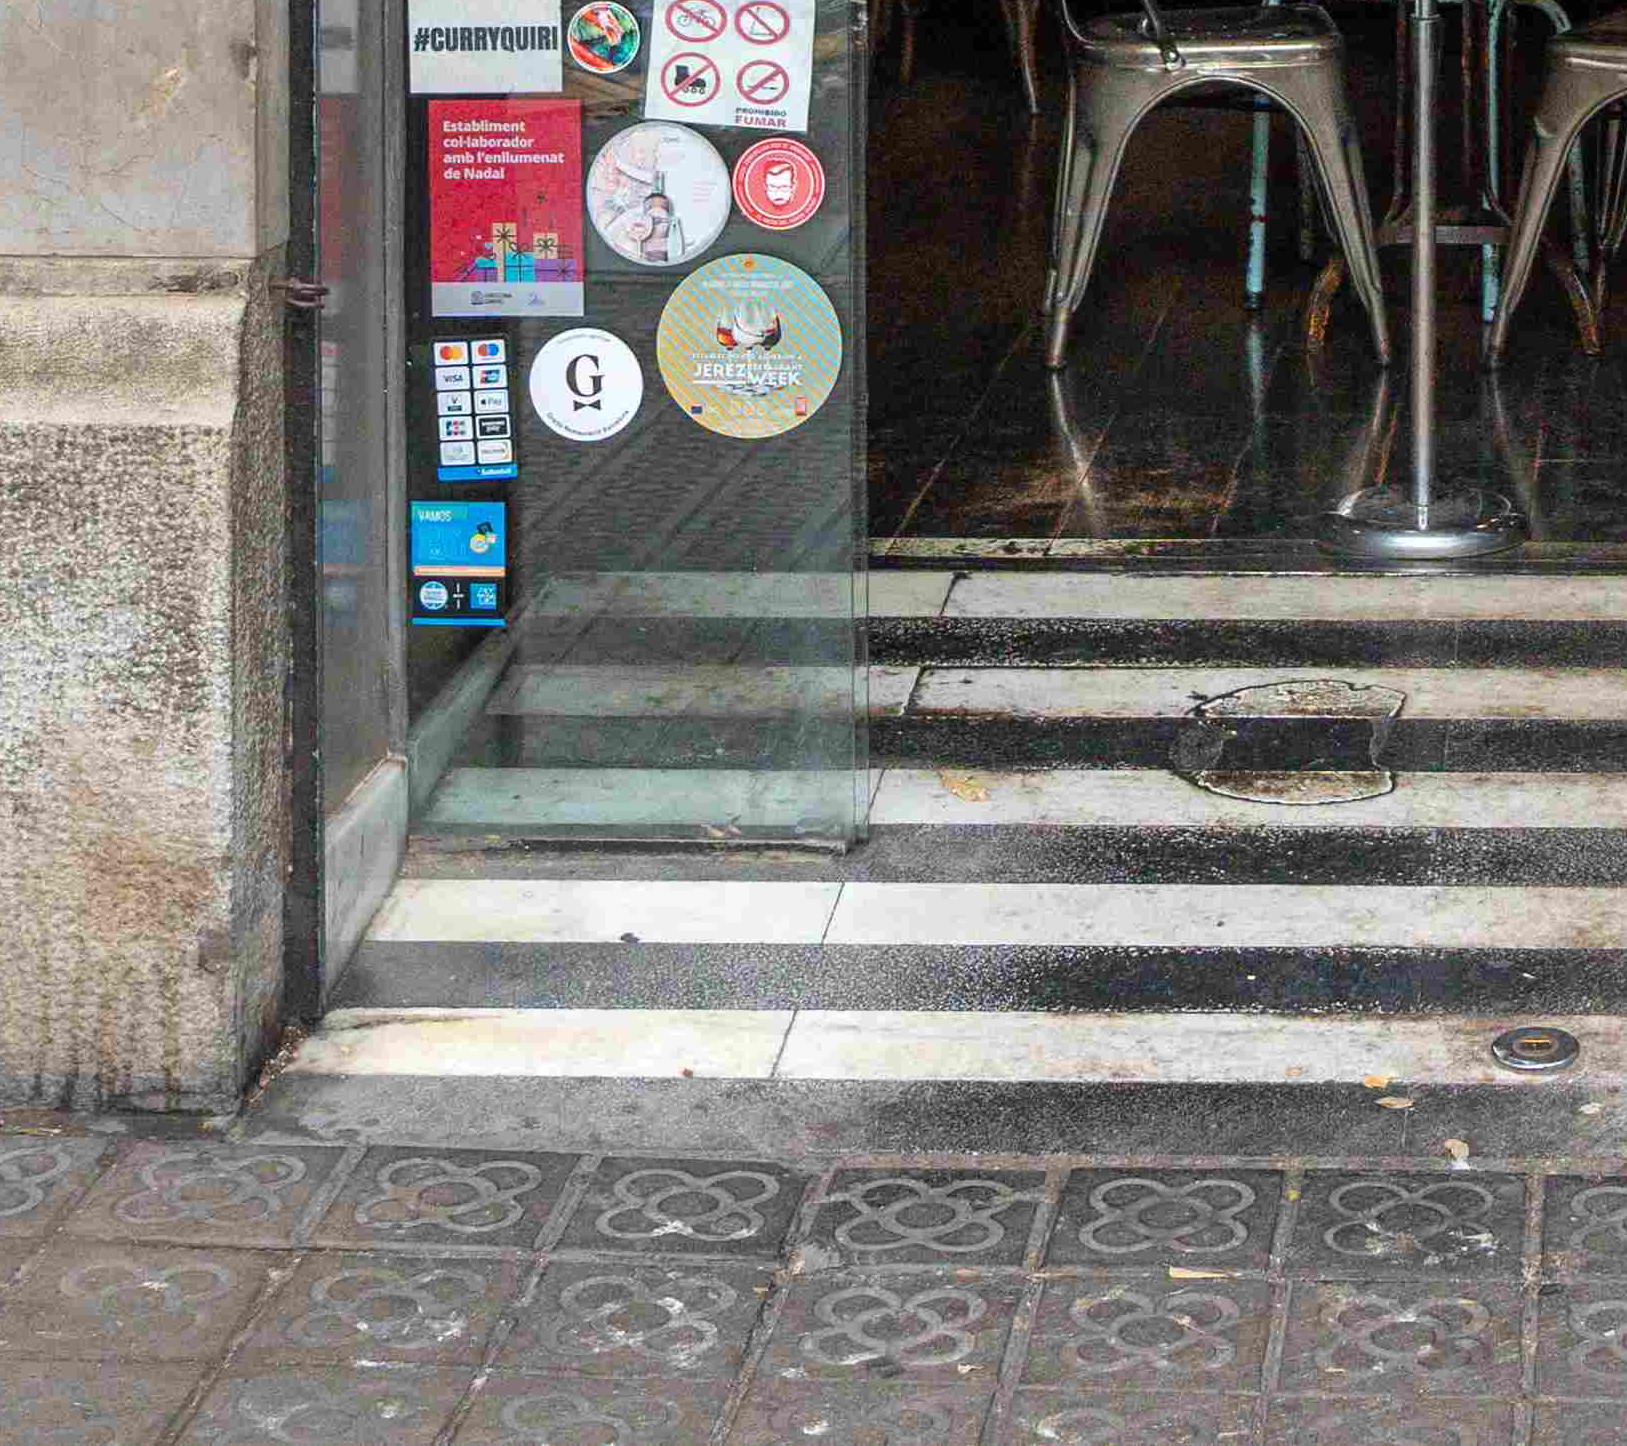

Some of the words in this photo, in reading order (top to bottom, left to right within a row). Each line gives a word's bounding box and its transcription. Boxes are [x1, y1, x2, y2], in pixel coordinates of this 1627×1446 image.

[413, 24, 558, 53] #CURRYQUIRI
[442, 120, 526, 133] Establiment
[734, 115, 788, 128] FUMAR
[443, 152, 475, 164] amb
[443, 168, 462, 180] de
[463, 167, 505, 180] Nadal
[692, 362, 745, 378] JEREZ
